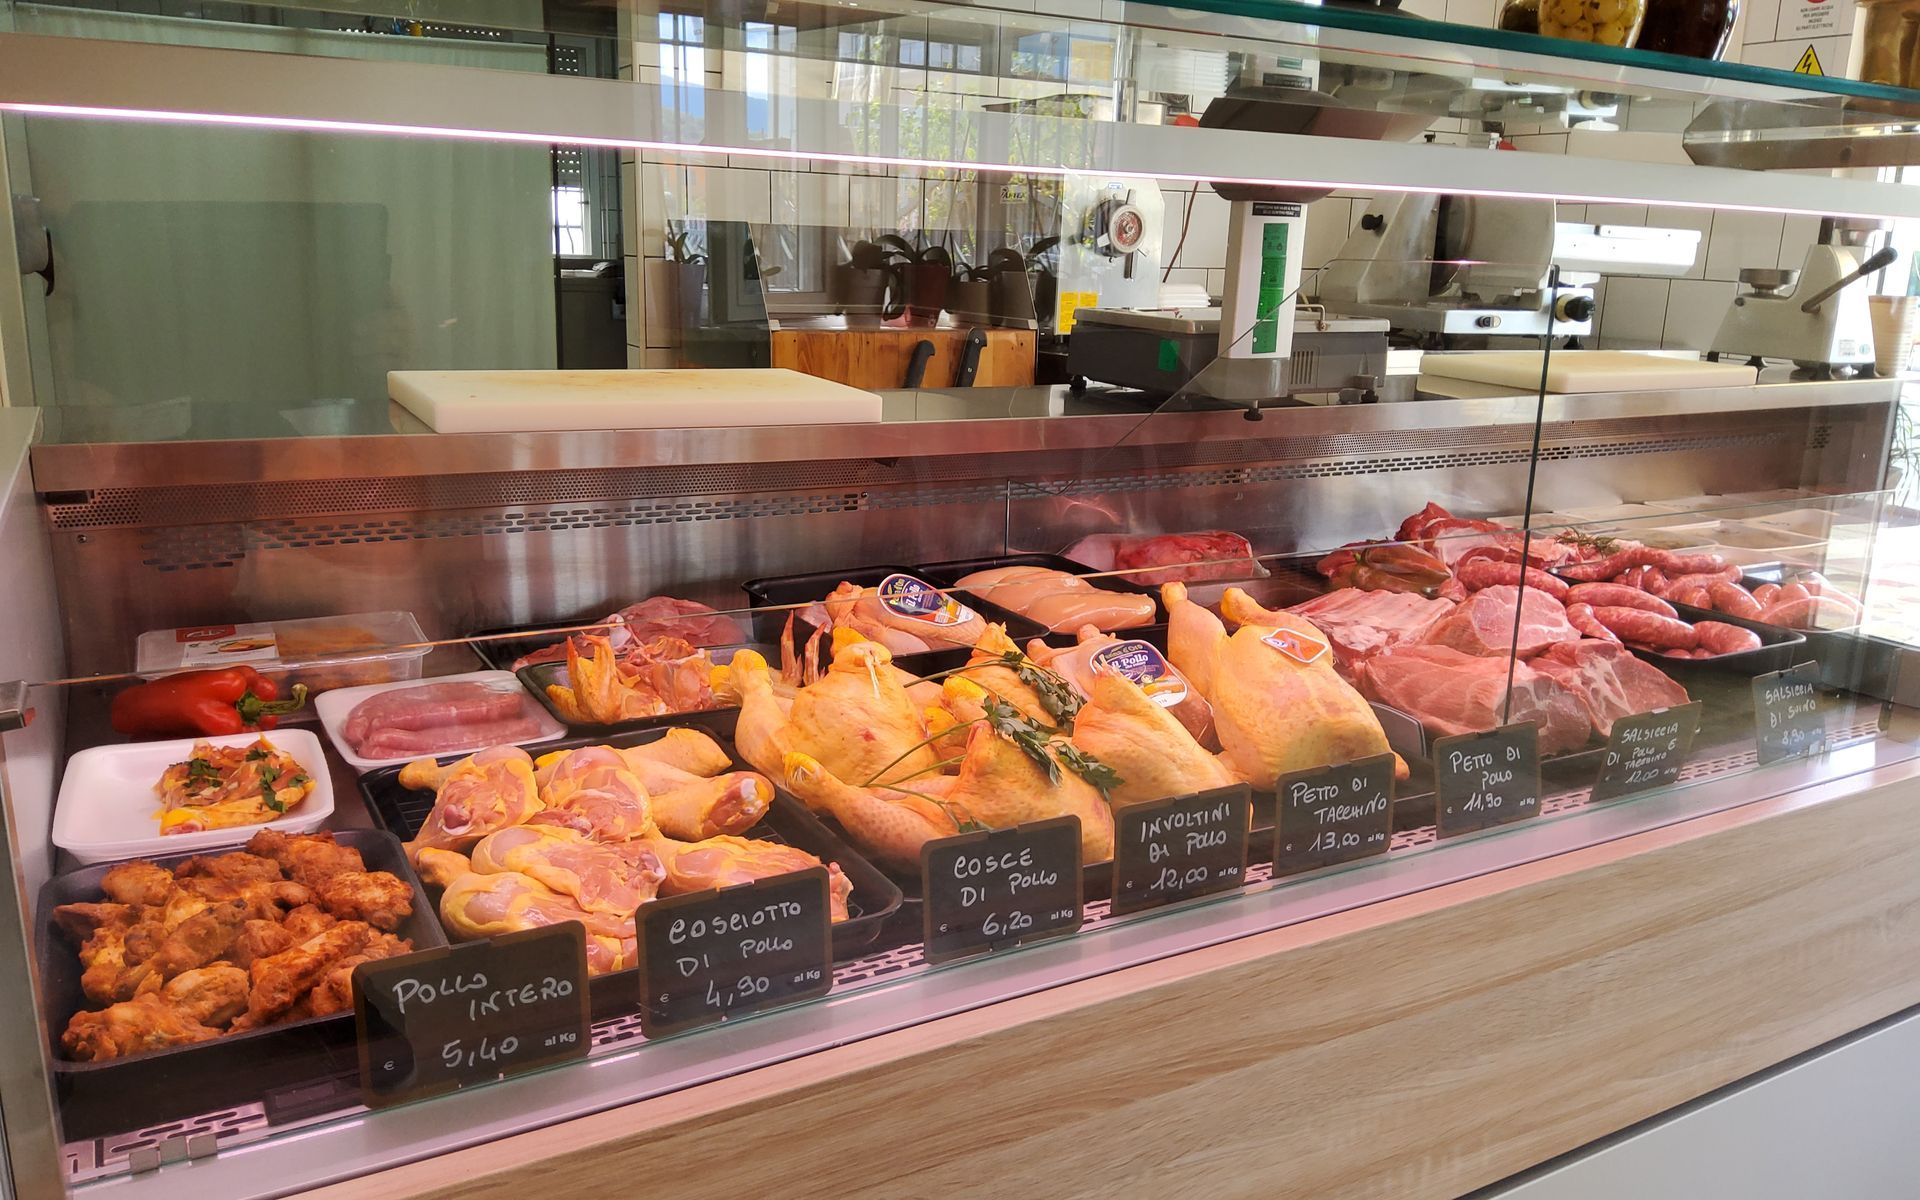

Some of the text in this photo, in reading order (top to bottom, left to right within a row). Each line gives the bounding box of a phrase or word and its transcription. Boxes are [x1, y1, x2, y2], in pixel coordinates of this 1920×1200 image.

[1120, 653, 1149, 666] Pollo
[1765, 682, 1814, 705] SALSICCIA
[1770, 699, 1816, 728] DI SUINO
[1621, 722, 1678, 744] SALSICCIA
[1450, 746, 1520, 774] PETTO DI
[1607, 738, 1676, 766] DI POLLO E
[1624, 752, 1667, 770] TACCHINO
[1291, 777, 1366, 807] PETTO DI
[1482, 770, 1512, 790] POLLO
[1314, 792, 1386, 824] TACCHINO
[1464, 792, 1502, 812] 11,90
[1141, 802, 1230, 842] INVOLTINI
[1149, 830, 1226, 863] DI POLLO
[954, 848, 1033, 878] COSCE
[1126, 866, 1238, 890] € 12,00 al Kg
[960, 870, 1057, 906] DI POLLO
[668, 901, 801, 944] COSCIOTTO
[940, 909, 1074, 936] € 6,20 al Kg
[676, 937, 793, 977] DI POLLO
[392, 973, 488, 1014] POLLO
[470, 977, 573, 1021] INTERO
[660, 970, 821, 1007] € 4,90 al Kg
[384, 1032, 577, 1070] € 5,40 al Kg
